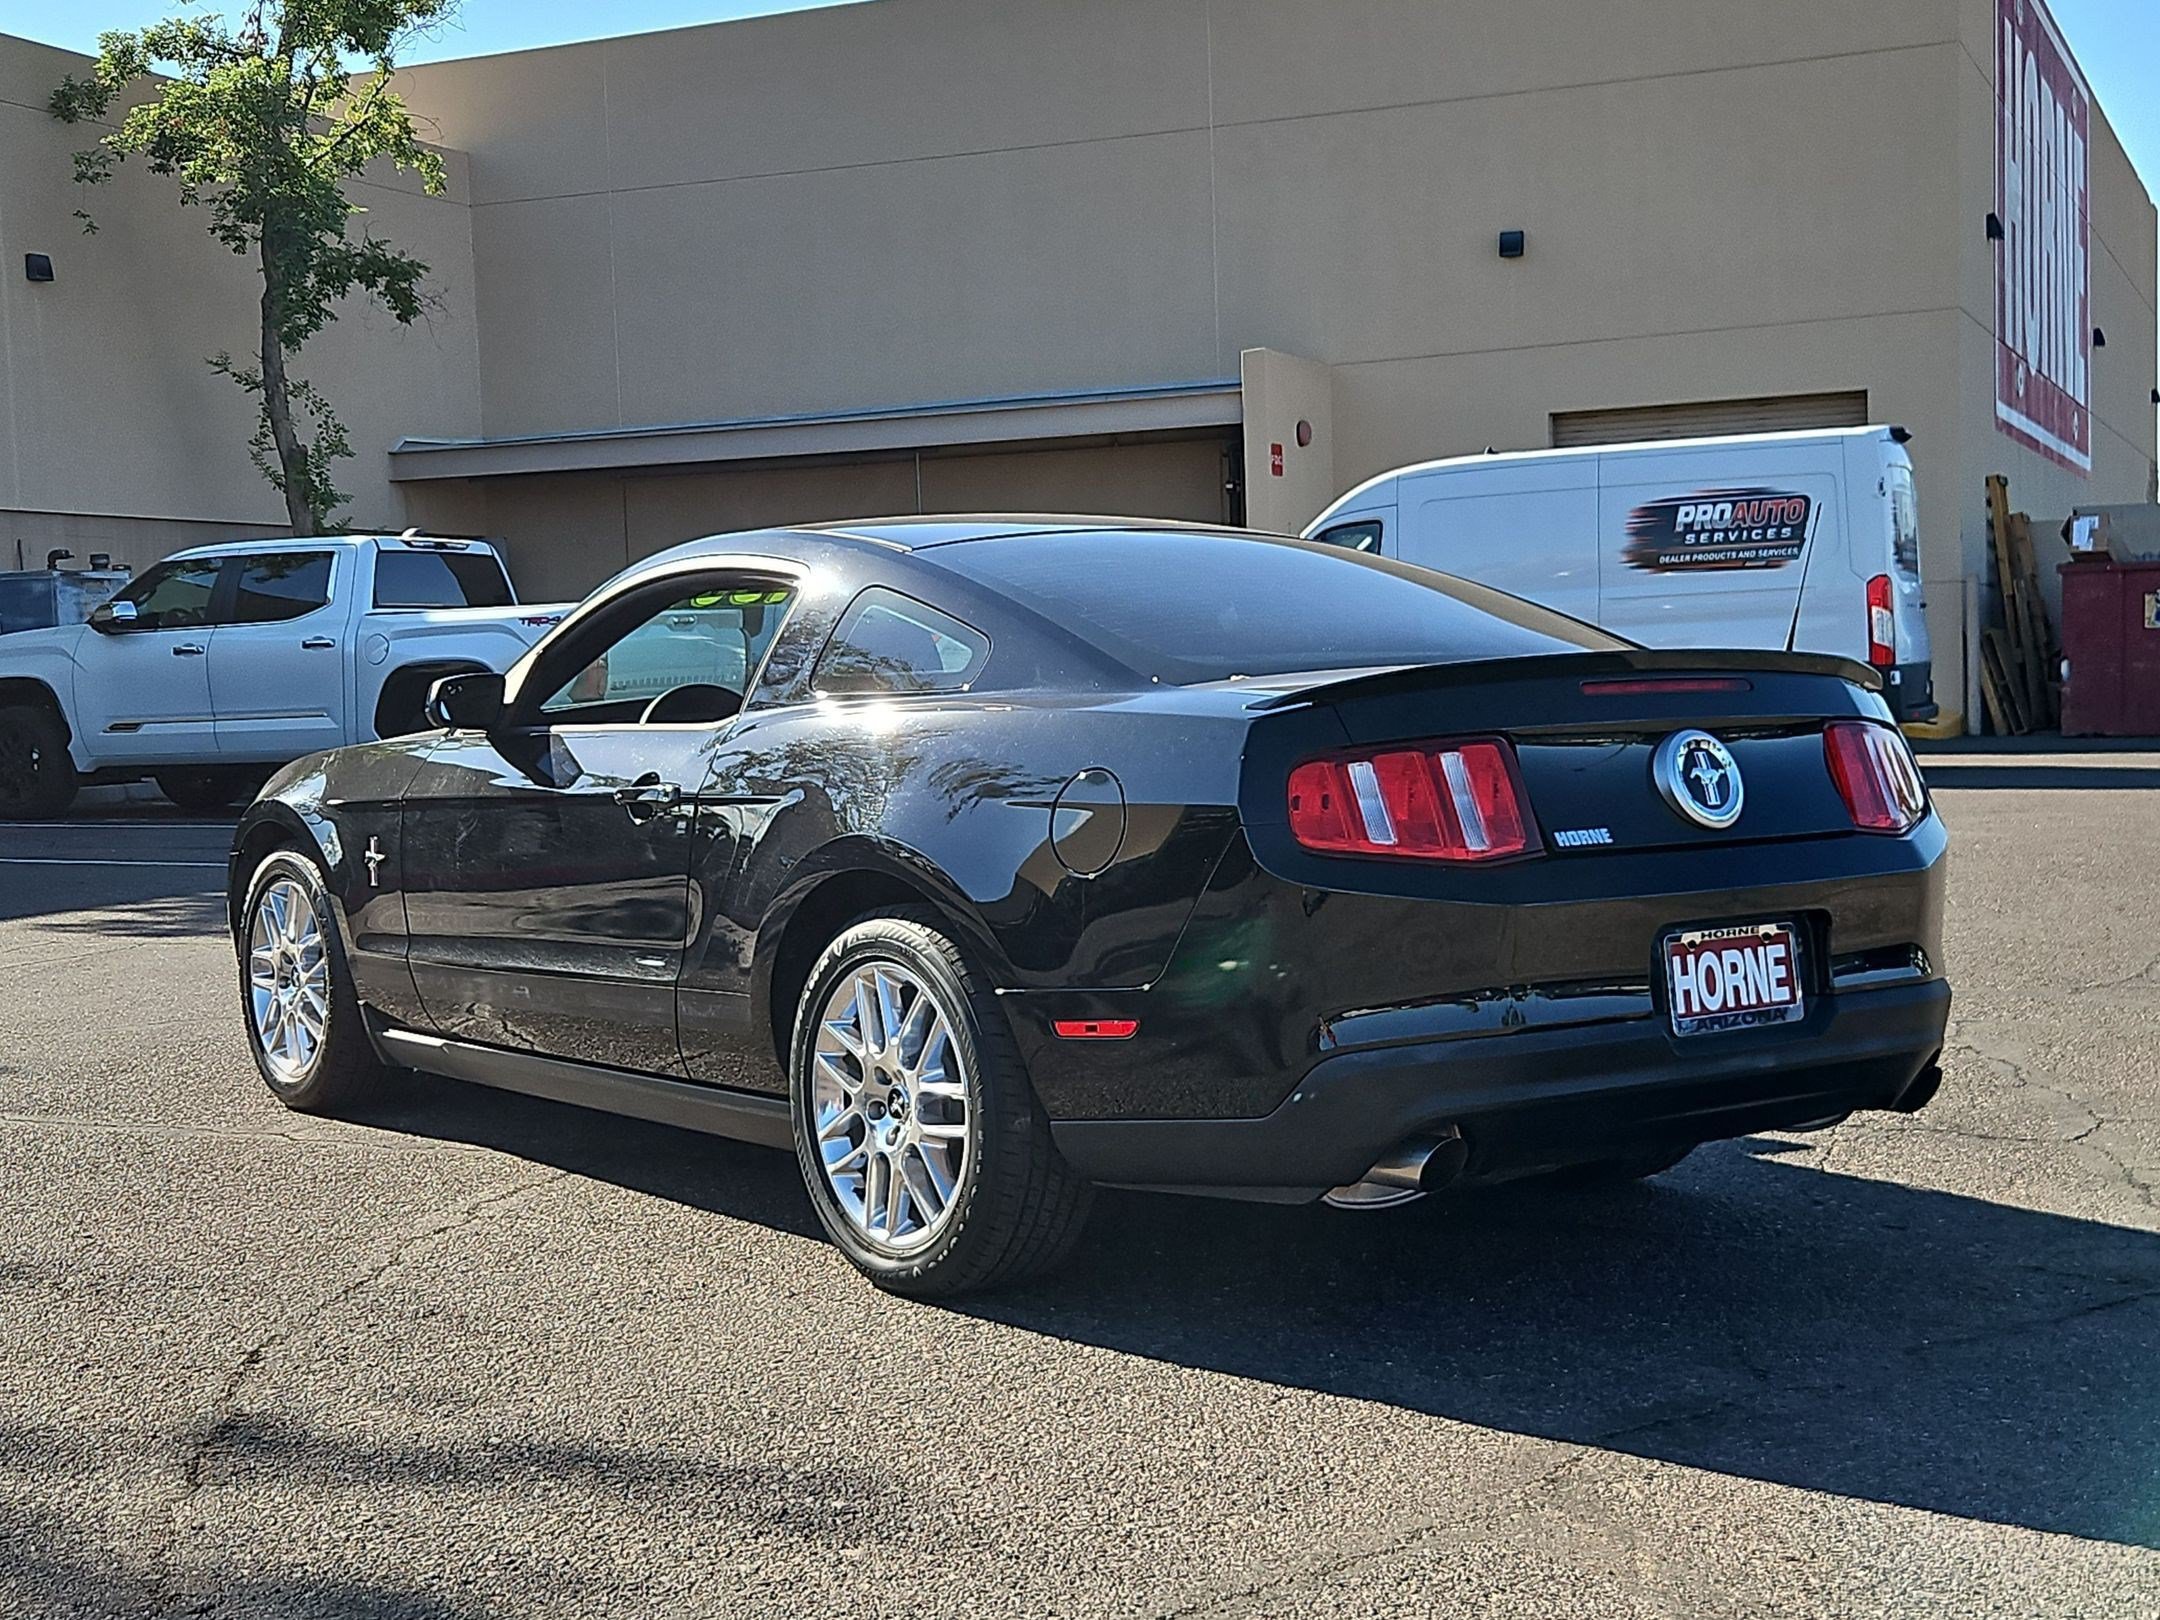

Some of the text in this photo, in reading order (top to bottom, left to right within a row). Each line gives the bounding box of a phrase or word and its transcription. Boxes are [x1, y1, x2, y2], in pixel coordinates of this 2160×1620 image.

[2004, 16, 2085, 406] HORNE
[1684, 527, 1792, 545] SERVICES
[1659, 546, 1799, 564] DEALER PRODUCTS AND SERVICES
[1553, 828, 1614, 847] HORNE
[1701, 926, 1760, 940] HORNE
[1672, 944, 1790, 1014] HORNE
